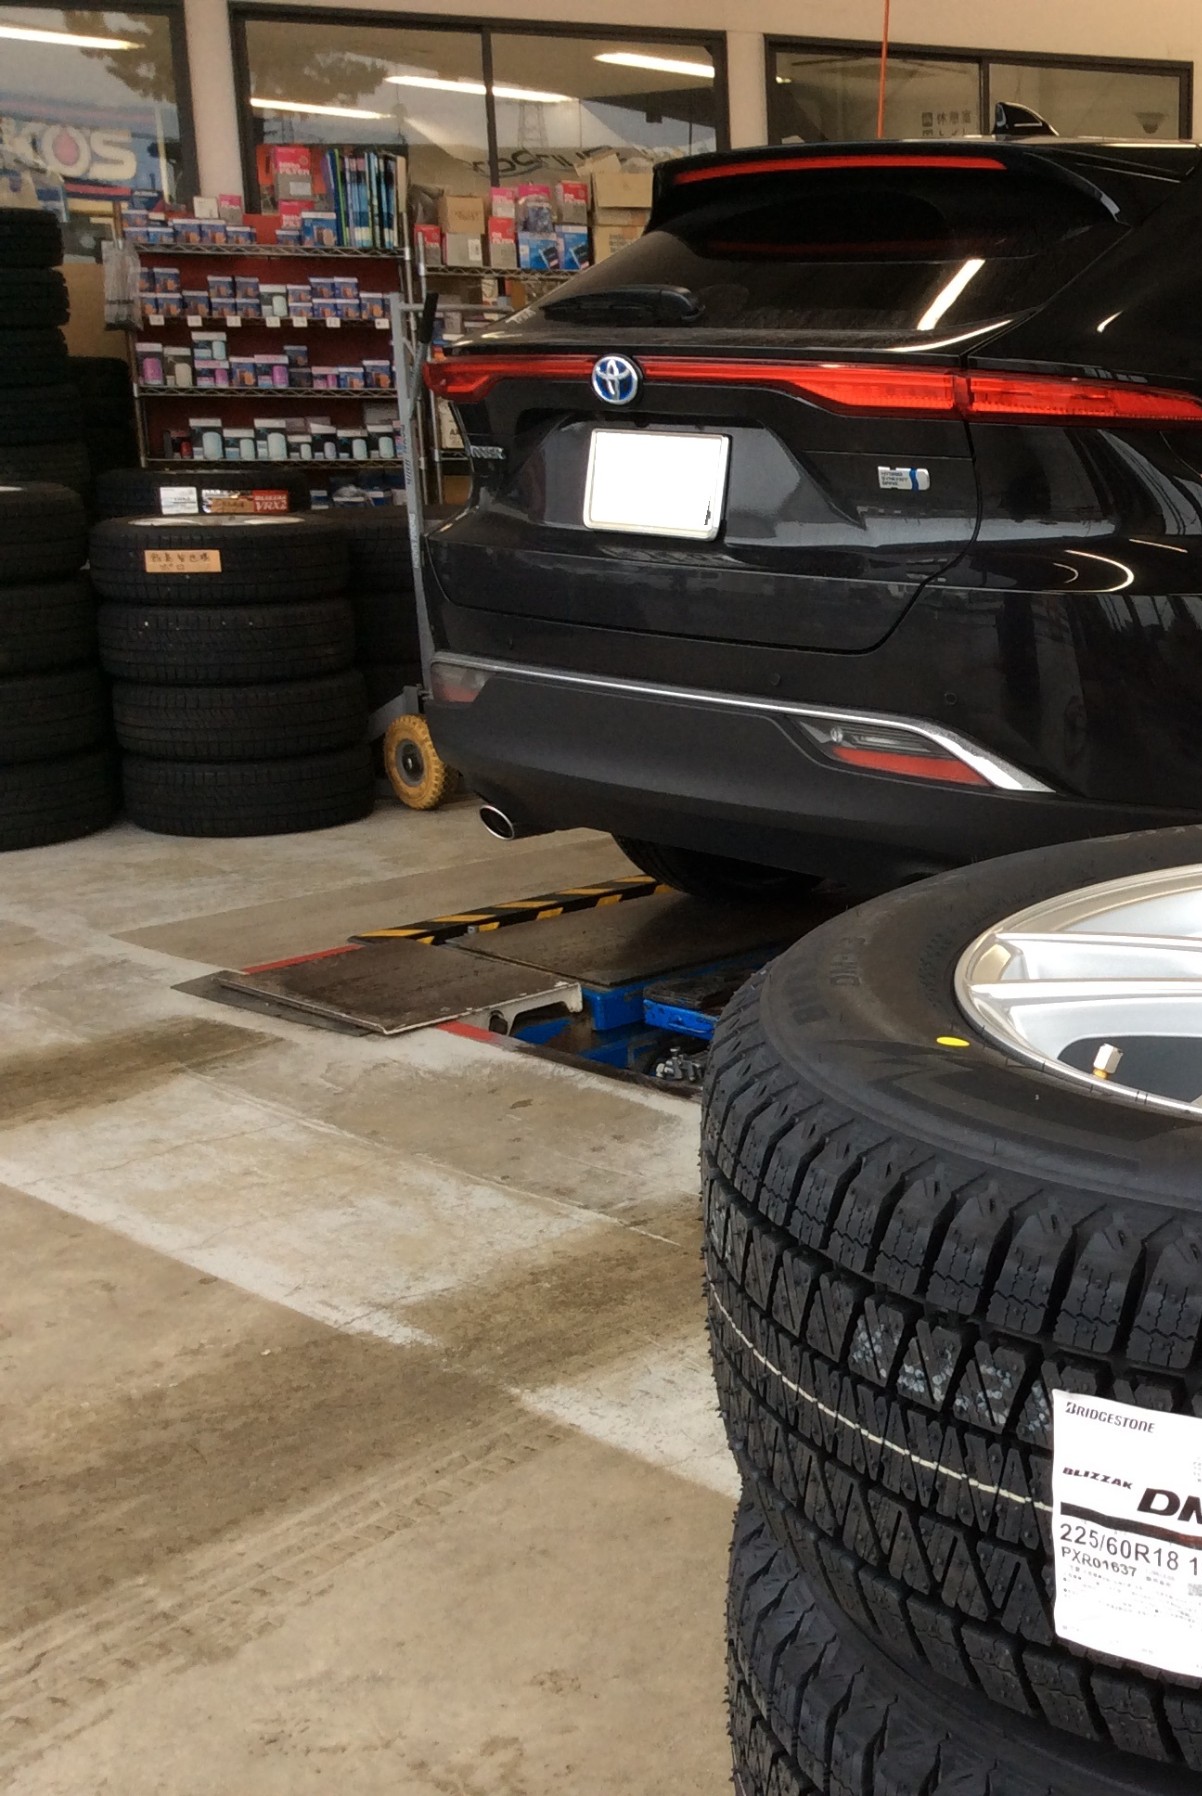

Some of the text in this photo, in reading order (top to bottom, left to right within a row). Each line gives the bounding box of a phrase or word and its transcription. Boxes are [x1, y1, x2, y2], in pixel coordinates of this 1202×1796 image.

[1065, 1401, 1155, 1433] BRIDGESTONE
[1062, 1467, 1133, 1490] BLIZZAK
[1060, 1523, 1179, 1571] 225/60R18
[1061, 1546, 1137, 1578] PXR01637
